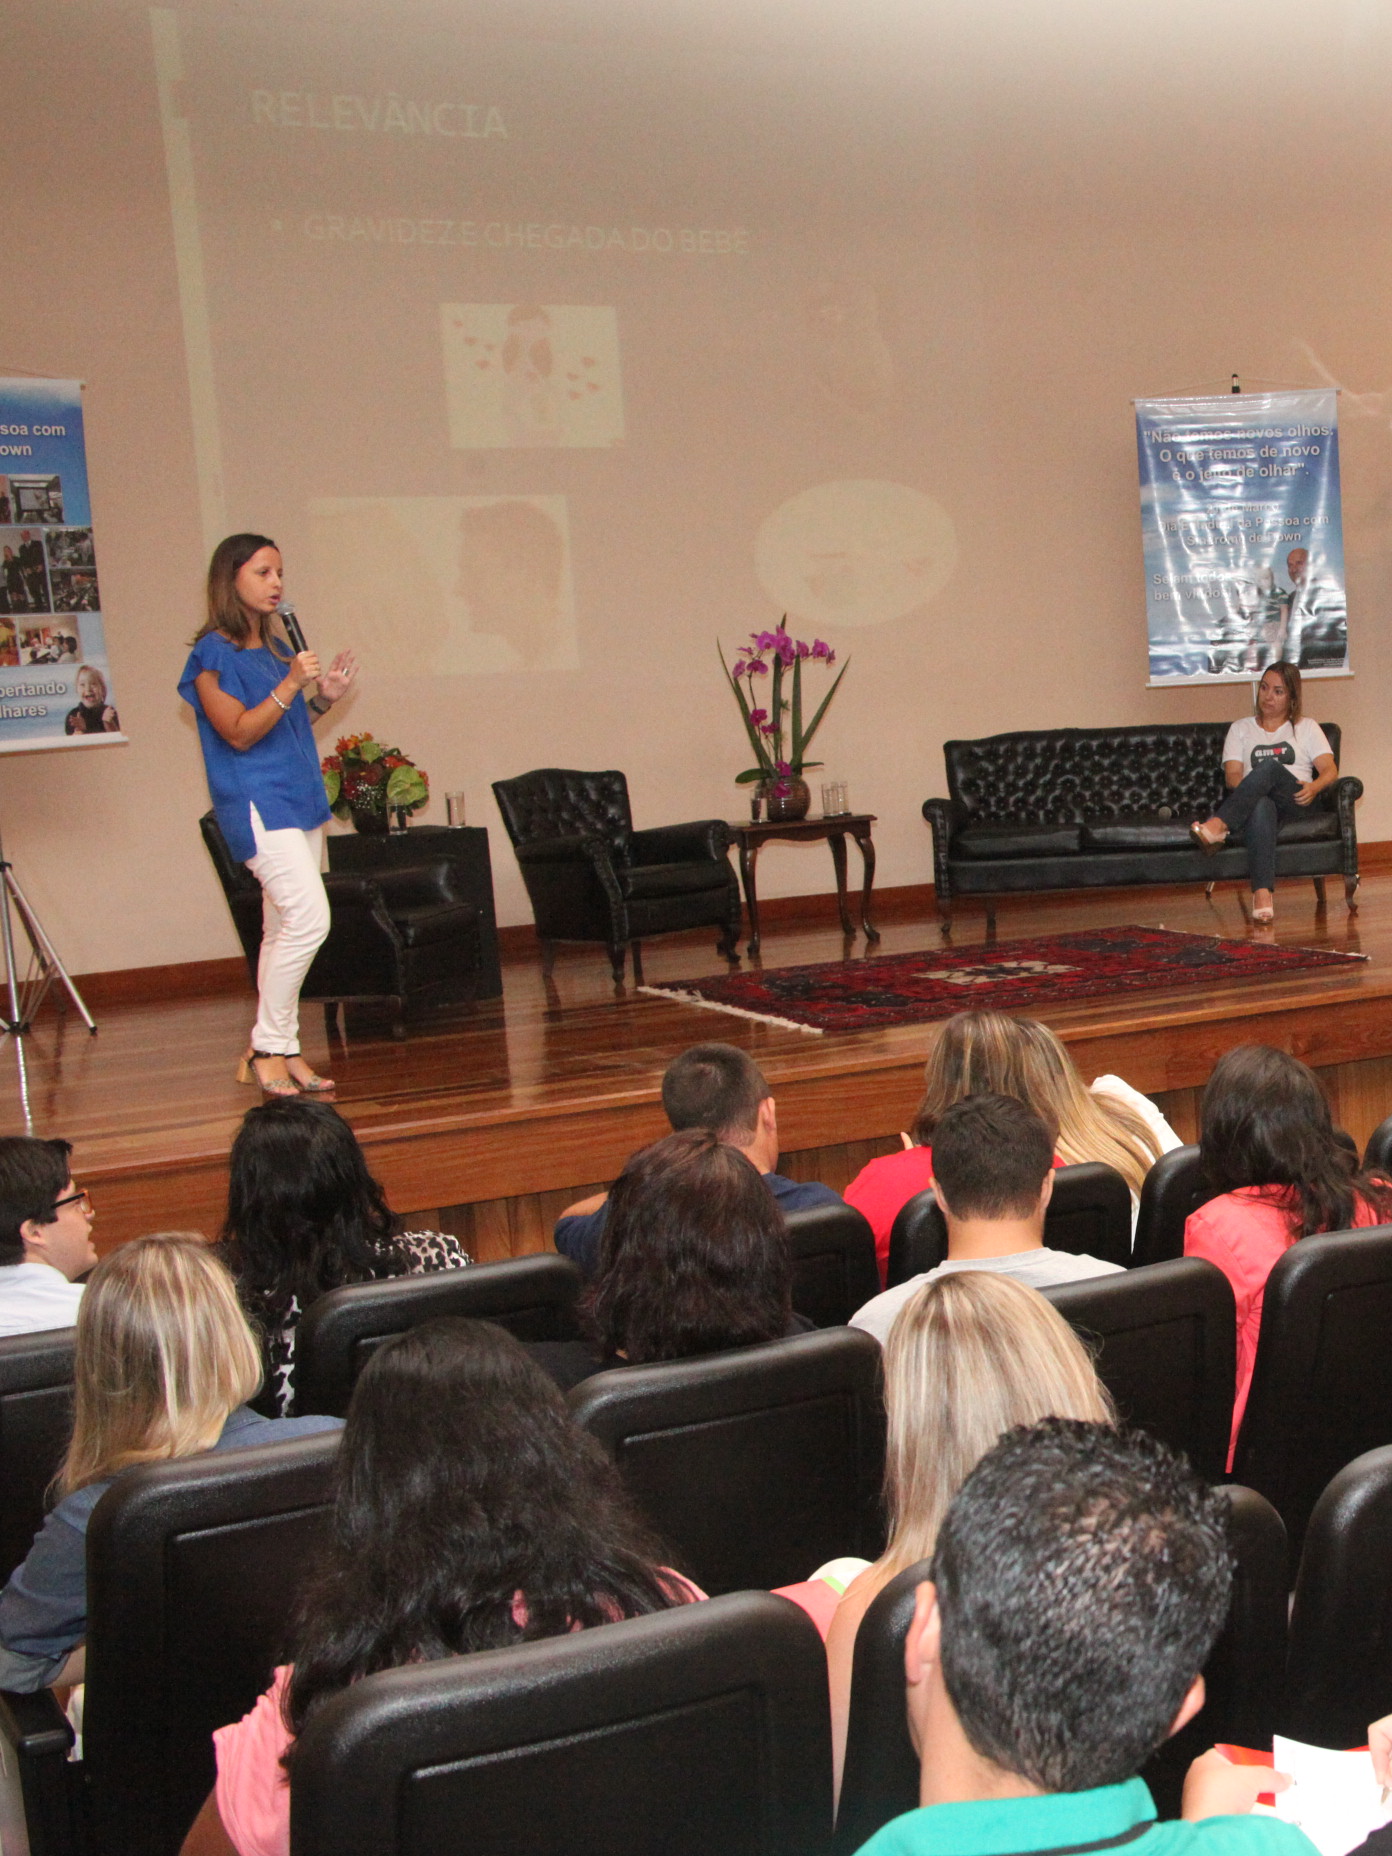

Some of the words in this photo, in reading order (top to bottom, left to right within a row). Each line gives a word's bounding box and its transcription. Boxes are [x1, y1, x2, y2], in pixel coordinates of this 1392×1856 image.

[303, 214, 456, 245] GRAVIDEZ
[484, 221, 625, 250] CHEGADA
[632, 227, 673, 252] DO
[33, 425, 66, 436] com
[1237, 427, 1282, 439] novos
[1288, 424, 1334, 437] olhos.
[1159, 450, 1172, 462] O
[1177, 451, 1204, 464] que
[1209, 448, 1255, 461] temos
[1260, 445, 1283, 457] de
[1284, 445, 1320, 457] novo
[1185, 470, 1195, 481] o
[1237, 465, 1255, 478] de
[1256, 516, 1300, 527] Pssoa
[1303, 515, 1329, 526] com
[1153, 572, 1191, 585] Seam
